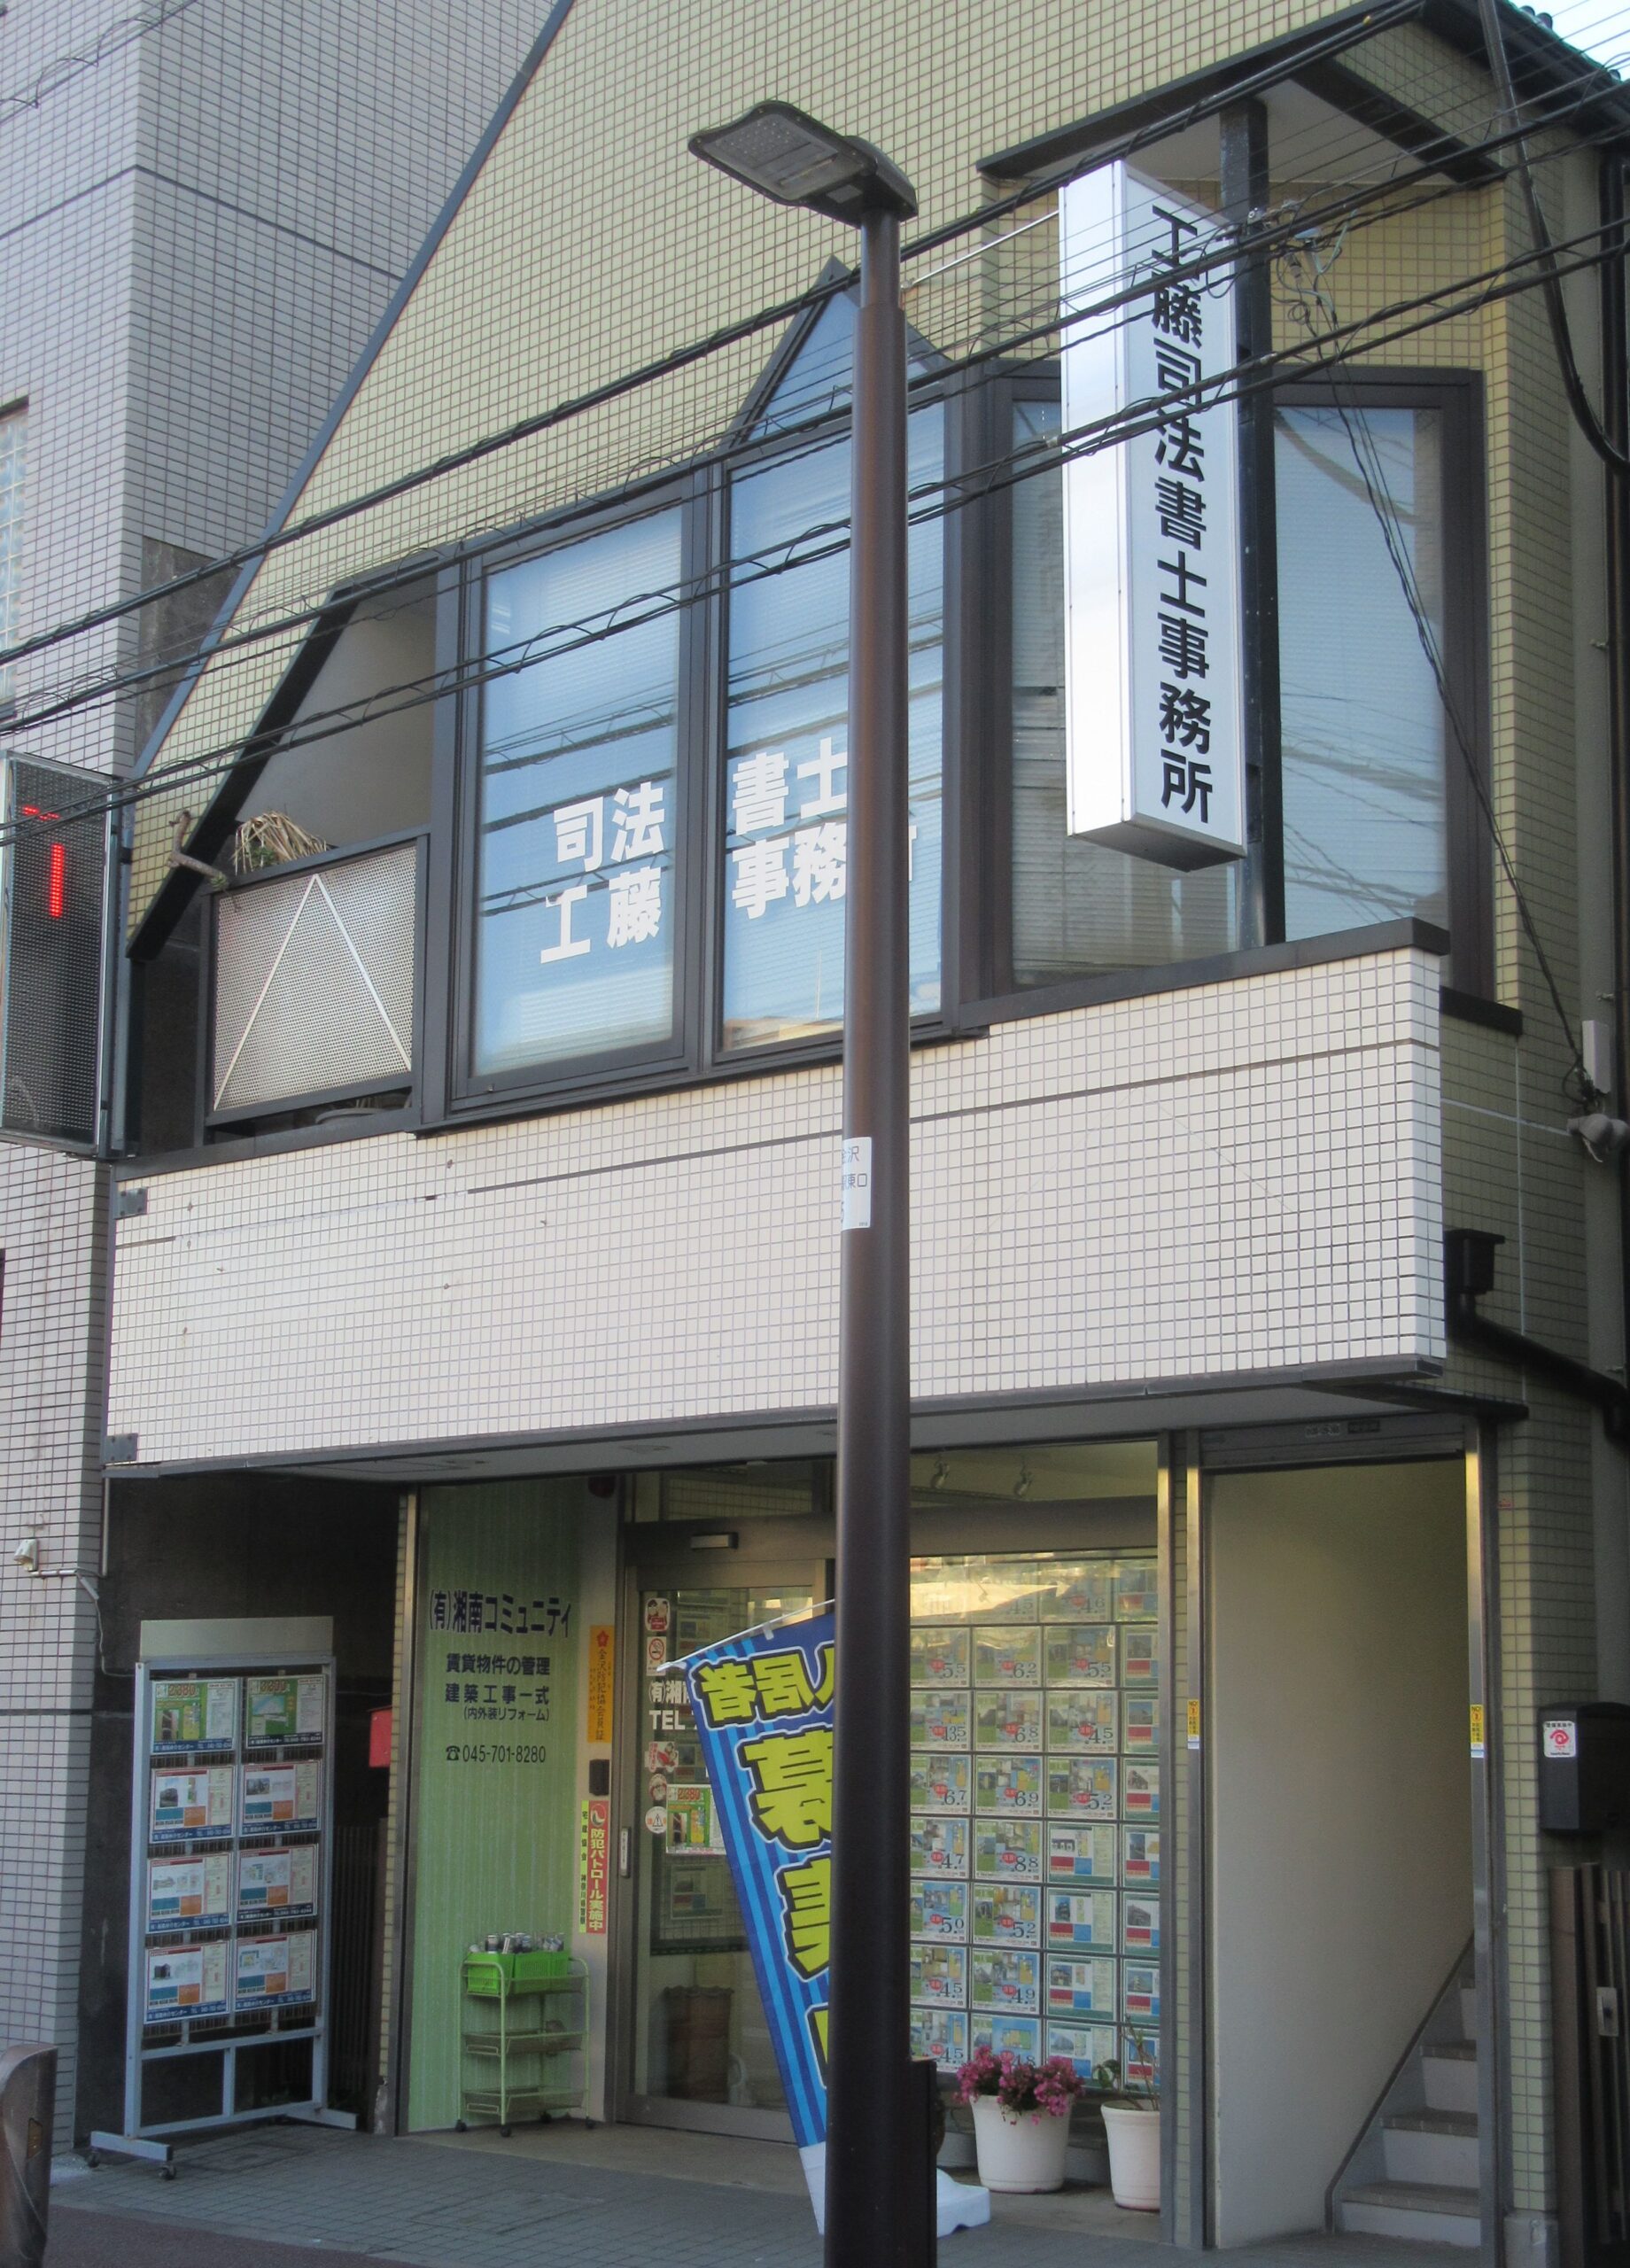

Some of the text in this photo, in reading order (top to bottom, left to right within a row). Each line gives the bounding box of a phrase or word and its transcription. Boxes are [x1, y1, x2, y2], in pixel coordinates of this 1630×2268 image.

[1152, 206, 1214, 824] 工藤司法書士事務所
[430, 1589, 571, 1637] (有)湘南コミュニティ
[446, 1653, 550, 1676] 賃貸物件の管理
[445, 1682, 549, 1705] 建築工事一式
[463, 1707, 549, 1721] (内外装リフォーム)
[648, 1710, 686, 1730] TEL
[462, 1745, 546, 1763] 045-701-8280
[588, 1829, 605, 1931] 防犯パトロール実施中
